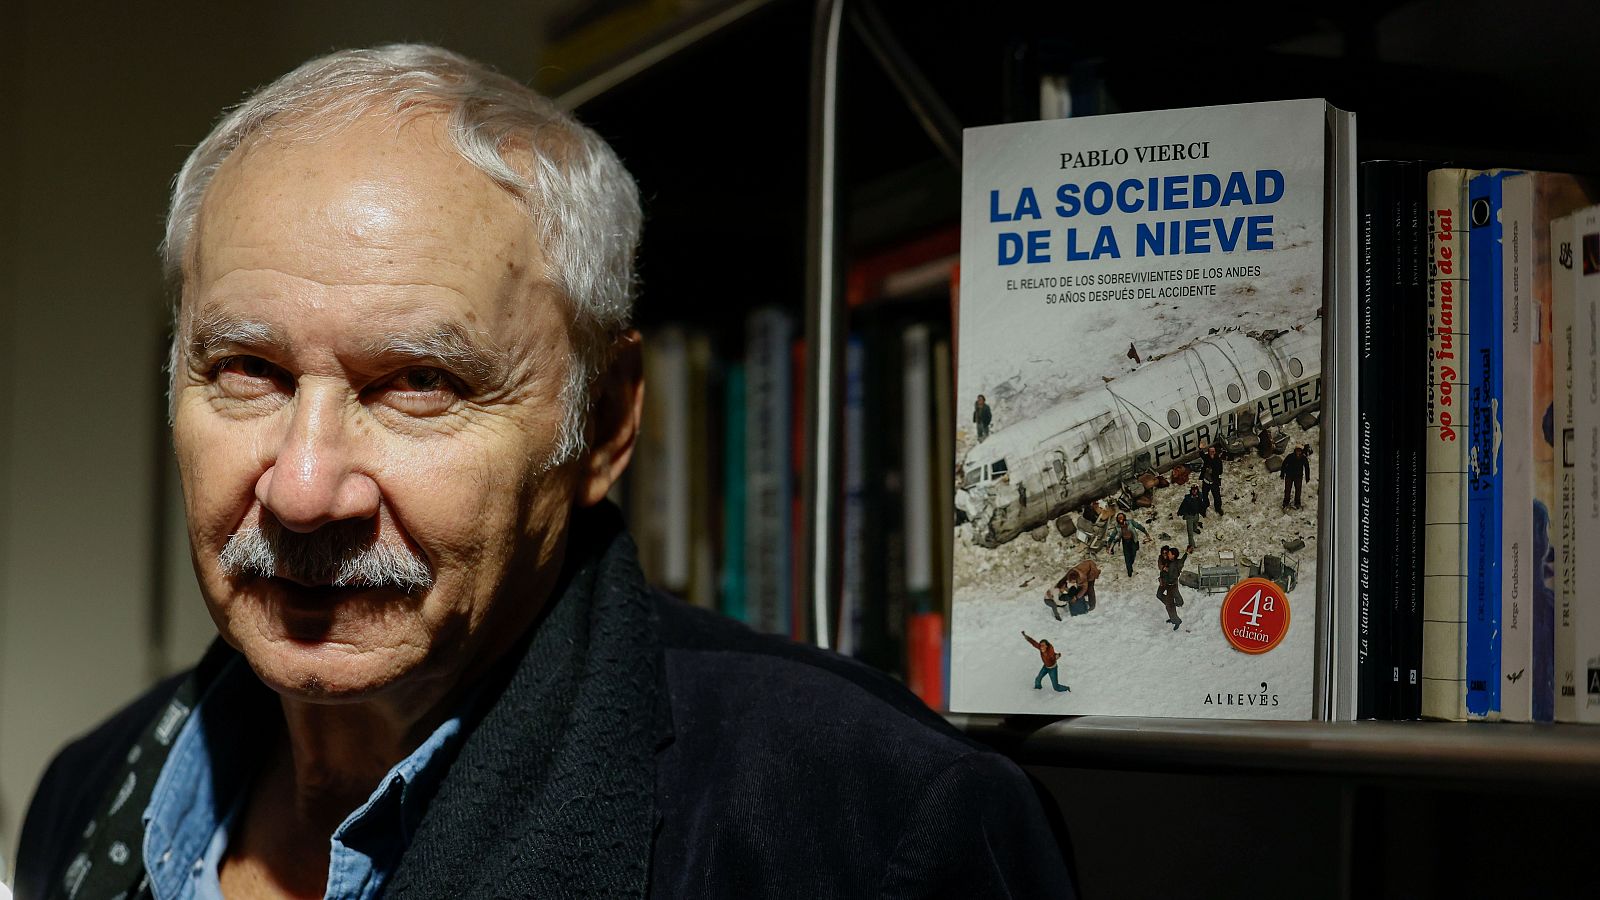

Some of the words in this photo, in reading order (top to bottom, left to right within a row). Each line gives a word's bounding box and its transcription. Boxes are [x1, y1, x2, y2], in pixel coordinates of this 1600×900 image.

[1060, 146, 1129, 170] PABLO
[1134, 141, 1211, 165] VIERCI
[989, 187, 1042, 224] LA
[1055, 169, 1286, 219] SOCIEDAD
[997, 229, 1052, 266] DE
[1066, 225, 1122, 262] LA
[1136, 215, 1275, 258] NIEVE
[1364, 212, 1373, 266] PETRELLI
[1436, 208, 1453, 243] tal
[1511, 219, 1519, 264] sombras
[1006, 279, 1019, 291] EL
[1020, 276, 1058, 290] RELATO
[1060, 275, 1073, 288] DE
[1075, 273, 1096, 287] LOS
[1097, 269, 1184, 286] SOBREVIVIENTES
[1185, 267, 1200, 280] DE
[1202, 266, 1223, 279] LOS
[1224, 264, 1262, 278] ANDES
[1437, 246, 1453, 276] de
[1046, 293, 1057, 305] 50
[1058, 289, 1087, 304] AÑOS
[1088, 285, 1135, 302] DESPUÉS
[1137, 286, 1158, 300] DEL
[1158, 282, 1217, 299] ACCIDENTE
[1364, 268, 1372, 304] MARIA
[1364, 305, 1372, 359] VITTORIO
[1427, 314, 1435, 342] de
[1435, 281, 1455, 361] fulana
[1510, 295, 1520, 334] Música
[1439, 366, 1457, 407] soy
[1480, 348, 1491, 403] sexual
[1439, 411, 1457, 442] yo
[1479, 406, 1491, 476] libertad
[1362, 465, 1372, 493] che
[1482, 480, 1494, 490] y
[1361, 496, 1372, 554] bambole
[1562, 473, 1570, 564] SILVESTRES
[1360, 556, 1371, 589] delle
[1510, 541, 1520, 600] Grubissich
[1360, 592, 1370, 636] stanza
[1510, 601, 1520, 630] Jorge
[1562, 567, 1570, 627] FRUTAS
[1232, 625, 1270, 643] edición
